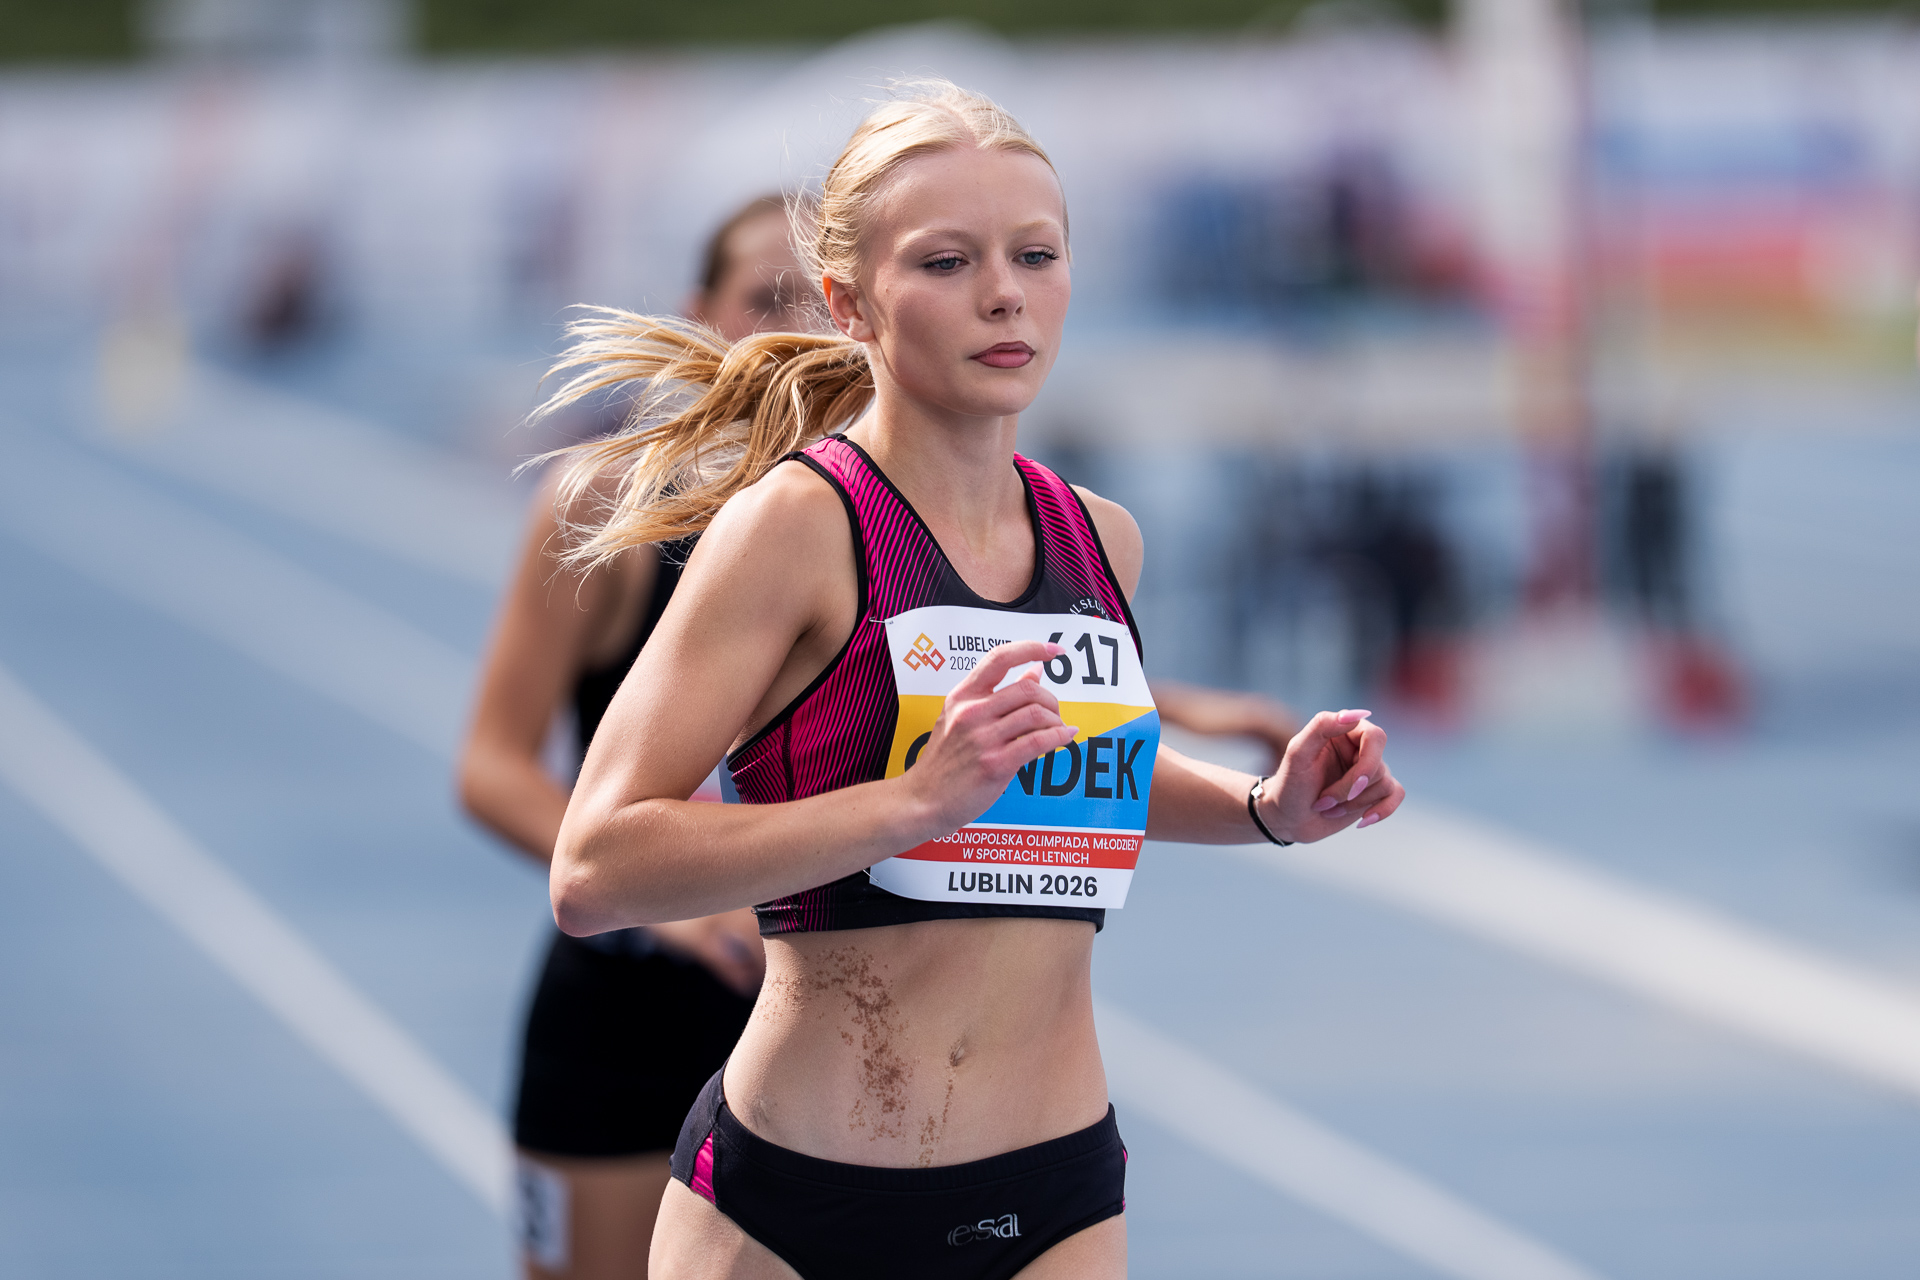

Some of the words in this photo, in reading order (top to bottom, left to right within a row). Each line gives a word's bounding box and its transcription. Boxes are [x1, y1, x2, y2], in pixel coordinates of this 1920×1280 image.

[949, 635, 1012, 652] LUBELS
[1043, 632, 1119, 686] 617
[904, 731, 1146, 801] NDEK
[1026, 834, 1090, 849] OLIMPIADA
[1093, 837, 1139, 851] MŁODZIEŻY
[962, 847, 975, 860] W
[976, 848, 1039, 862] SPORTACH
[1042, 850, 1090, 865] LETNICH
[948, 871, 1033, 895] LUBLIN
[1039, 874, 1098, 897] 2026
